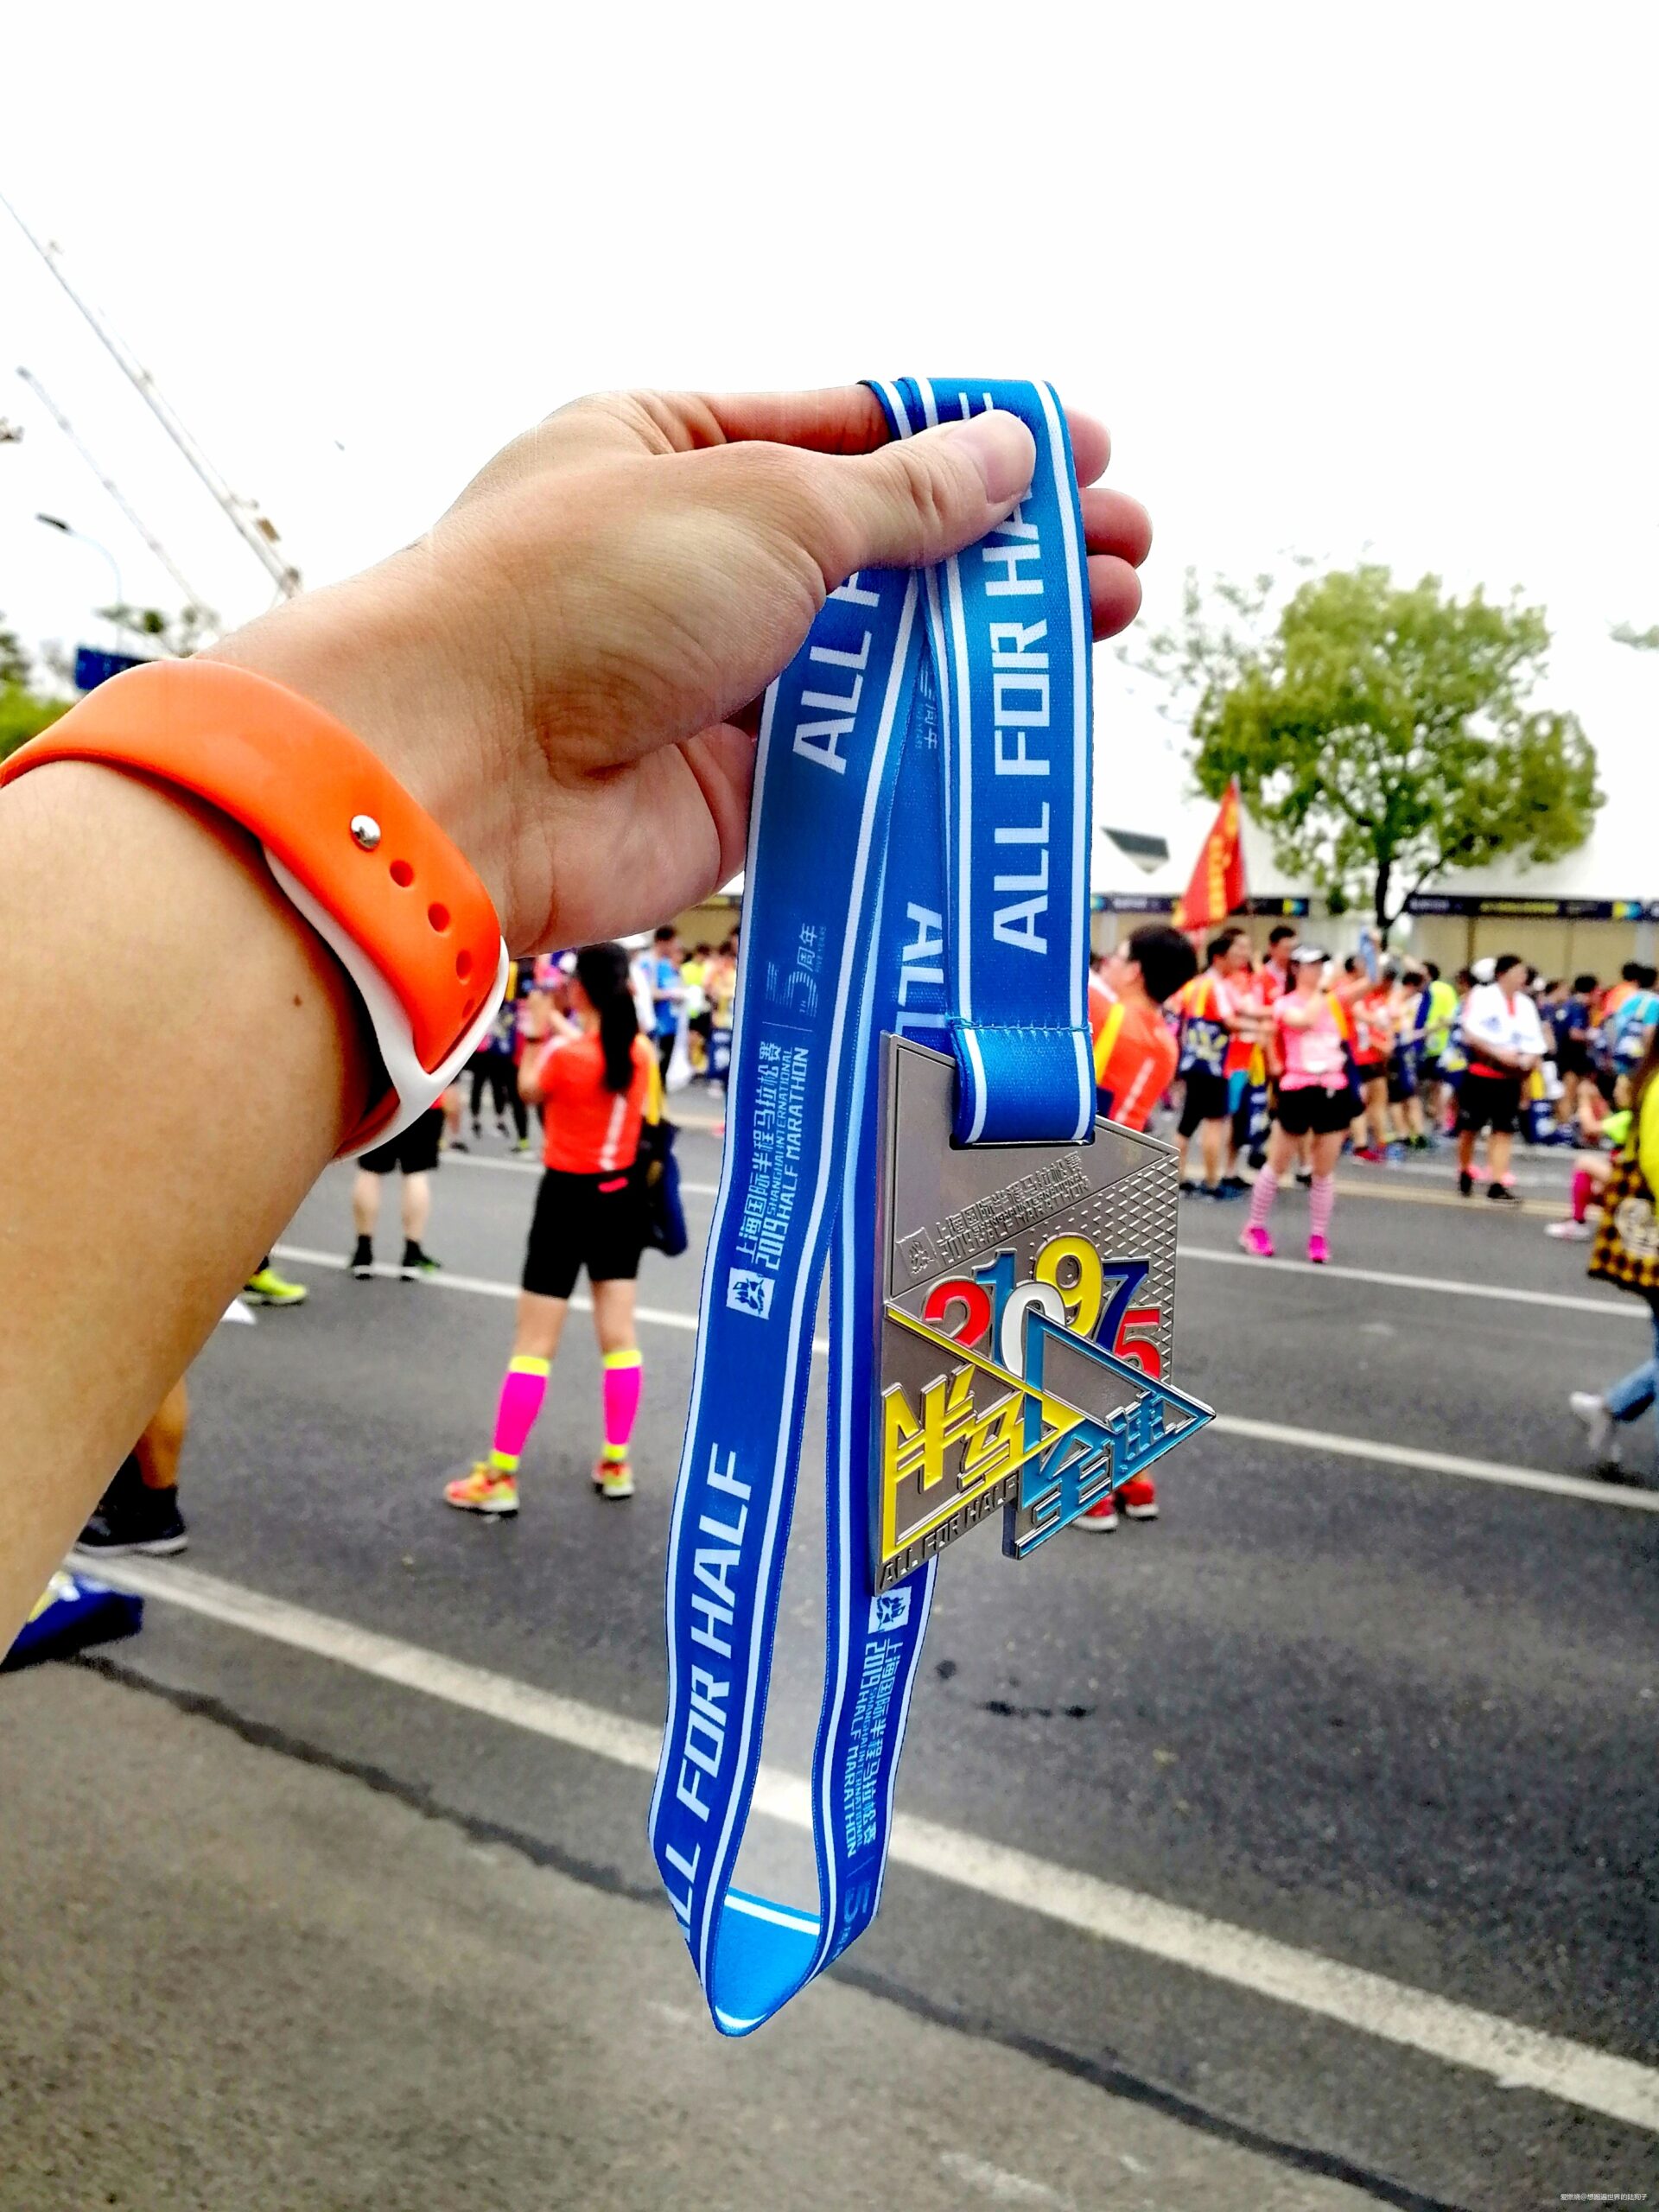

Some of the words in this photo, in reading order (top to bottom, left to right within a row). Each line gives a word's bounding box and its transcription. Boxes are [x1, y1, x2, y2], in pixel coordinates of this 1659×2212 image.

[792, 632, 873, 774] ALL
[989, 619, 1051, 776] FOR
[994, 802, 1049, 955] ALL
[895, 901, 944, 1036] ALL
[736, 1041, 781, 1264] 上海国际半程马拉松赛
[785, 1046, 809, 1160] MARATHON
[755, 1216, 789, 1271] 2019
[776, 1165, 798, 1220] HALF
[691, 1443, 751, 1657] HALF
[880, 1547, 918, 1590] ALL
[922, 1514, 961, 1560] FOR
[964, 1473, 1018, 1528] HALF
[676, 1664, 729, 1822] FOR
[850, 1689, 869, 1740] HALF
[862, 1638, 903, 1845] 上海国际半程马拉松赛
[844, 1745, 859, 1859] MARATHON
[665, 1843, 701, 1942] LL
